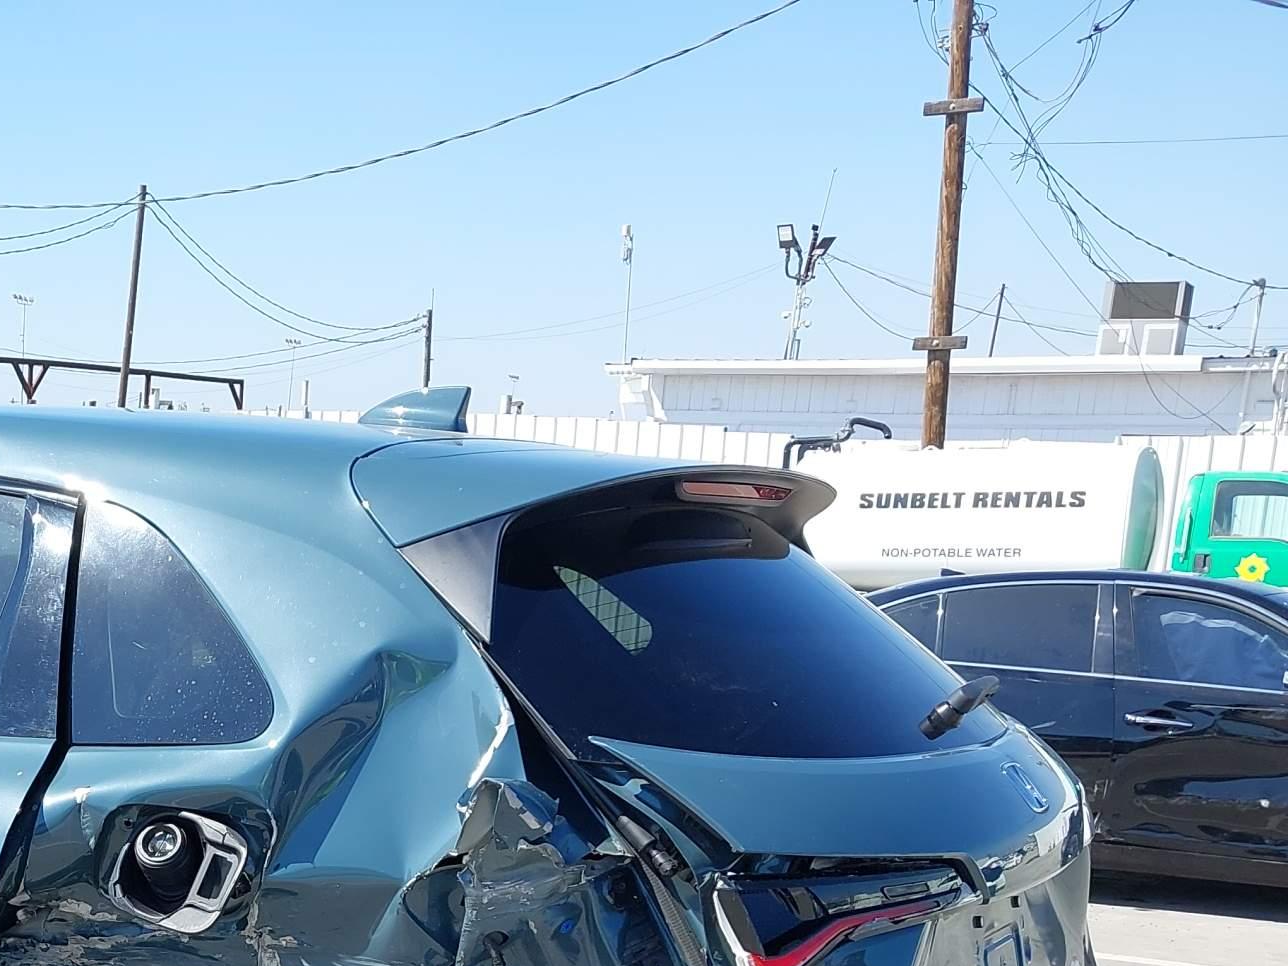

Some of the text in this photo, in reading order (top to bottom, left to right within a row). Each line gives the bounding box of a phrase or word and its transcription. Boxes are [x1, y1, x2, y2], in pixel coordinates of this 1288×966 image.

[859, 490, 1087, 509] SUNBELT RENTALS
[881, 548, 1022, 558] NON-POTABLE WATER
